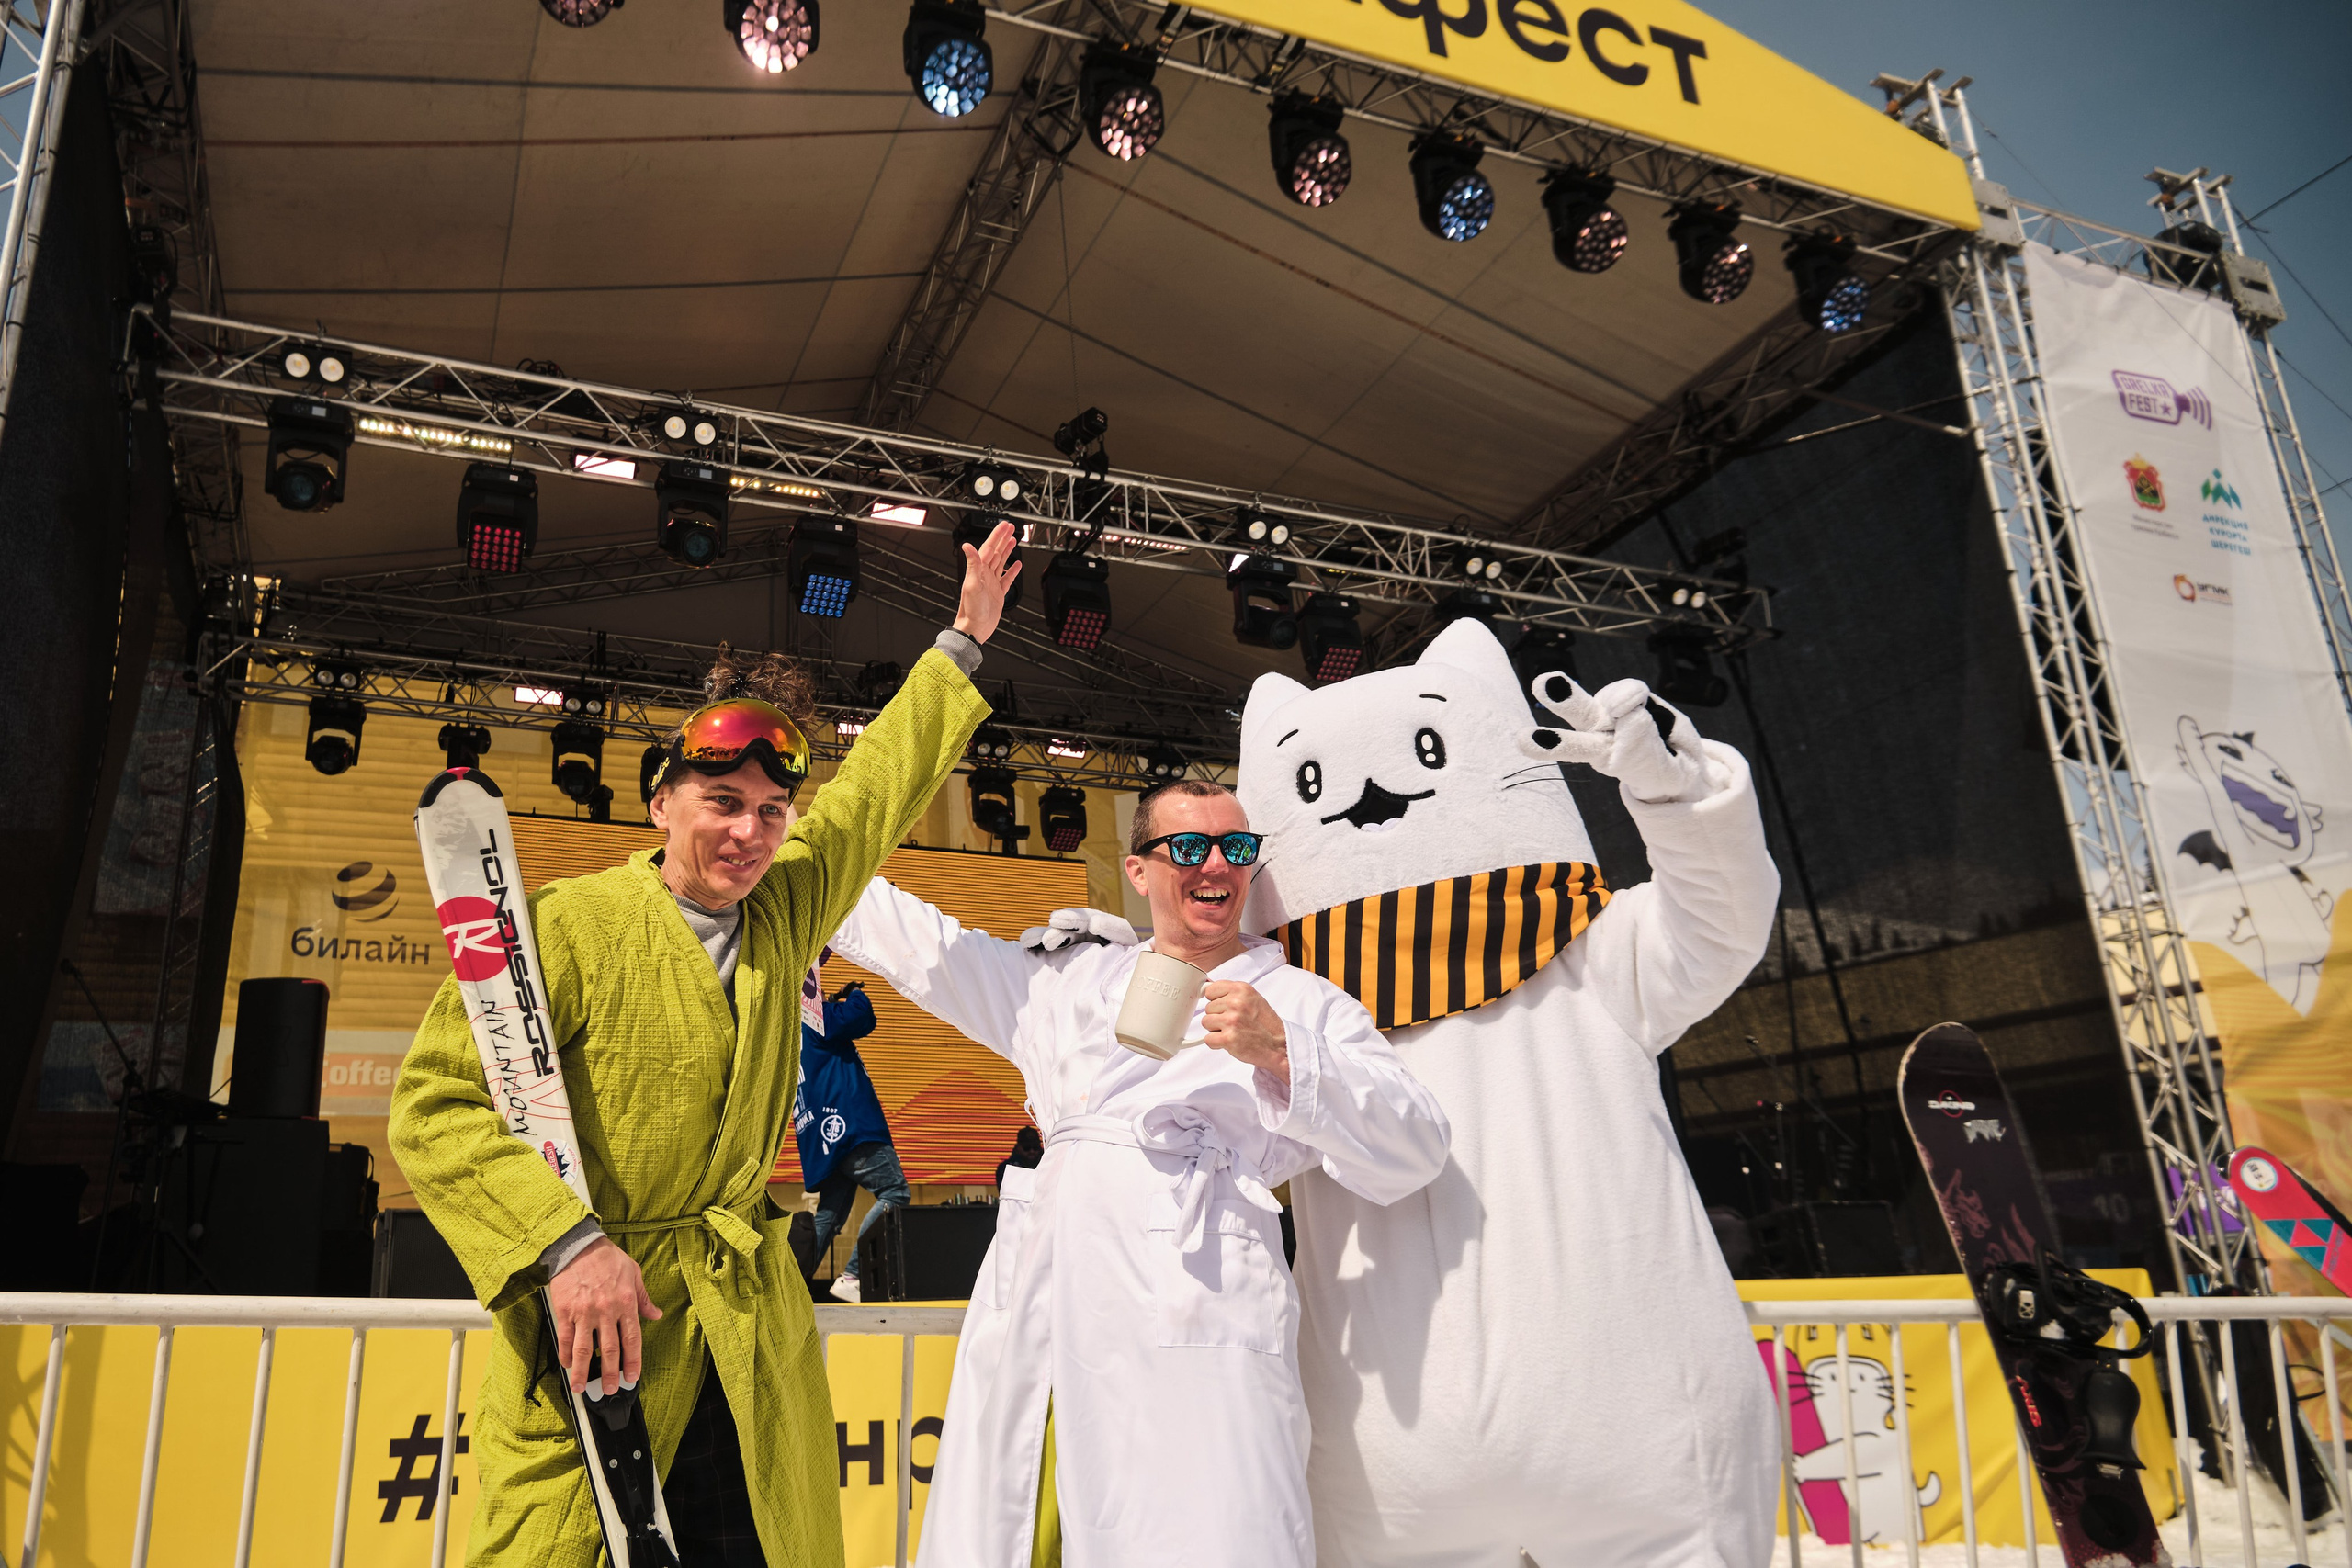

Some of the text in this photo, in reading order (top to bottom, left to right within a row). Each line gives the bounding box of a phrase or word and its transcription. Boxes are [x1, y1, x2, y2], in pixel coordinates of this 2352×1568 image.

[2120, 376, 2169, 398] GRELKA
[2128, 392, 2159, 414] FEST
[2202, 513, 2249, 531] ДИРЕКЦИЯ
[2211, 539, 2251, 556] ШЕРЕГЕШ
[290, 926, 430, 965] билайн
[480, 829, 555, 1078] ROSSIGNOL
[481, 998, 537, 1137] MOUNTAIN
